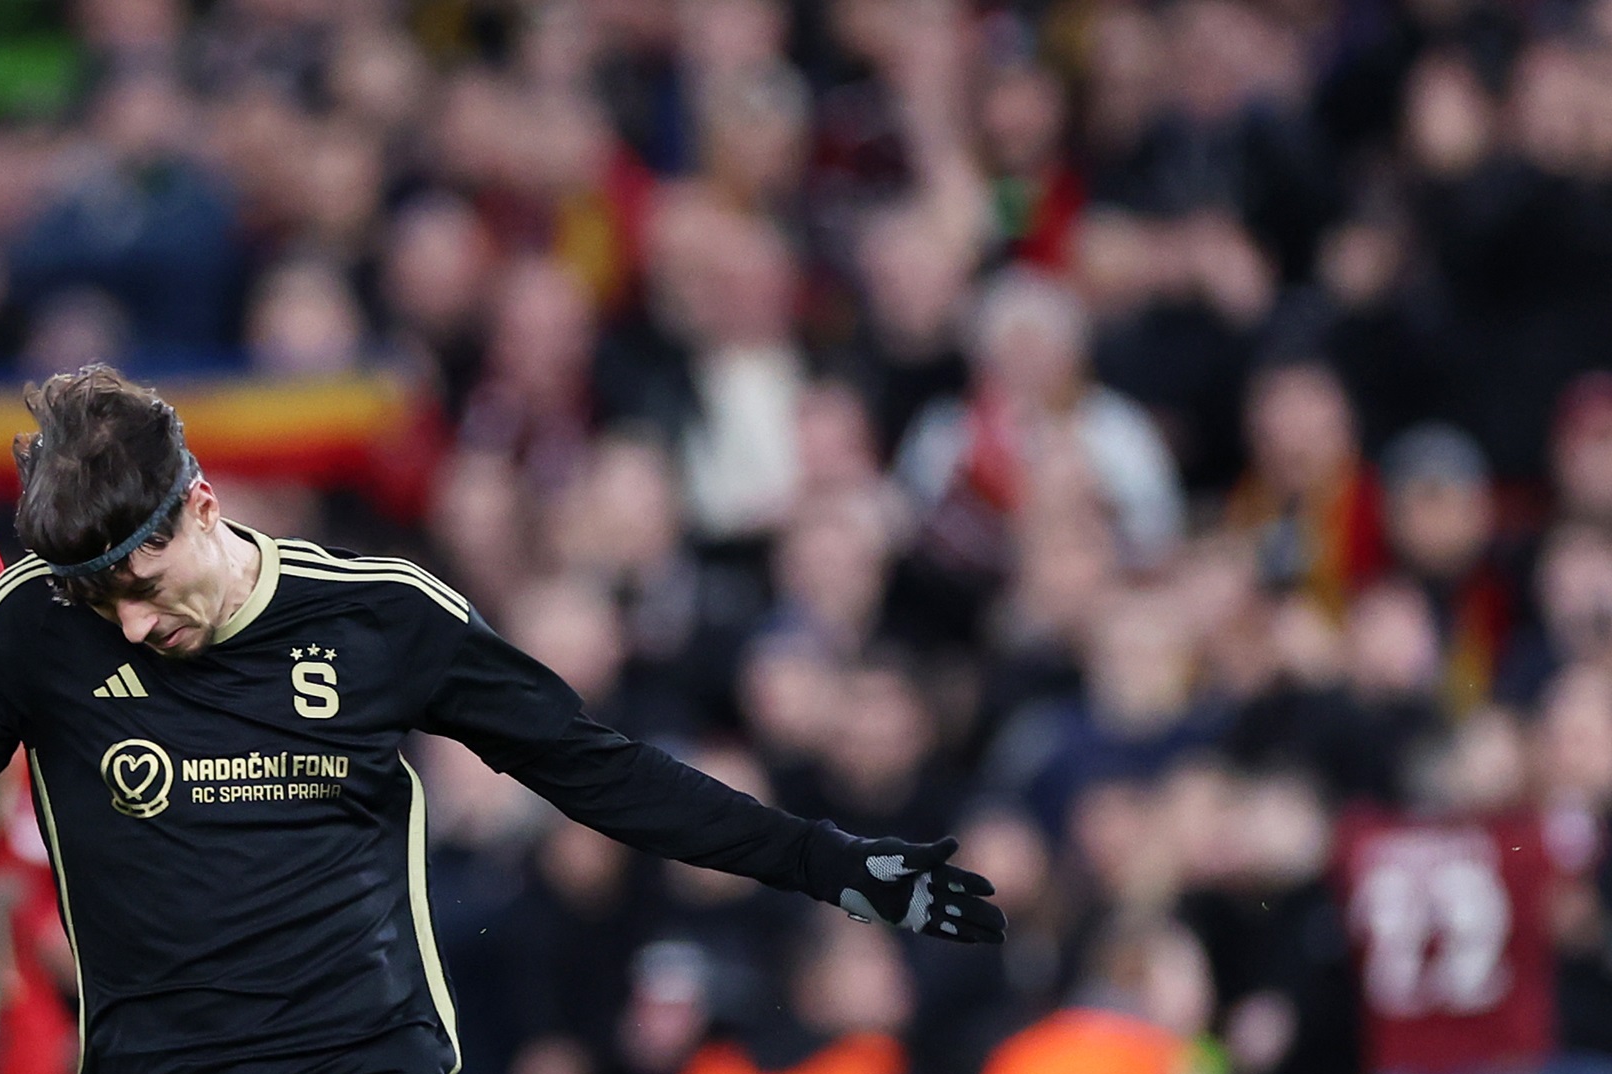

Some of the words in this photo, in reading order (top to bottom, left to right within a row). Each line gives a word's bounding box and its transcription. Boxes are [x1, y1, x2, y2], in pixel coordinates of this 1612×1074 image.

[291, 661, 340, 719] S
[182, 752, 288, 782] NADAČNÍ
[292, 754, 349, 779] FOND
[191, 786, 216, 804] AC
[219, 784, 285, 803] SPARTA
[287, 783, 342, 800] PRAHA
